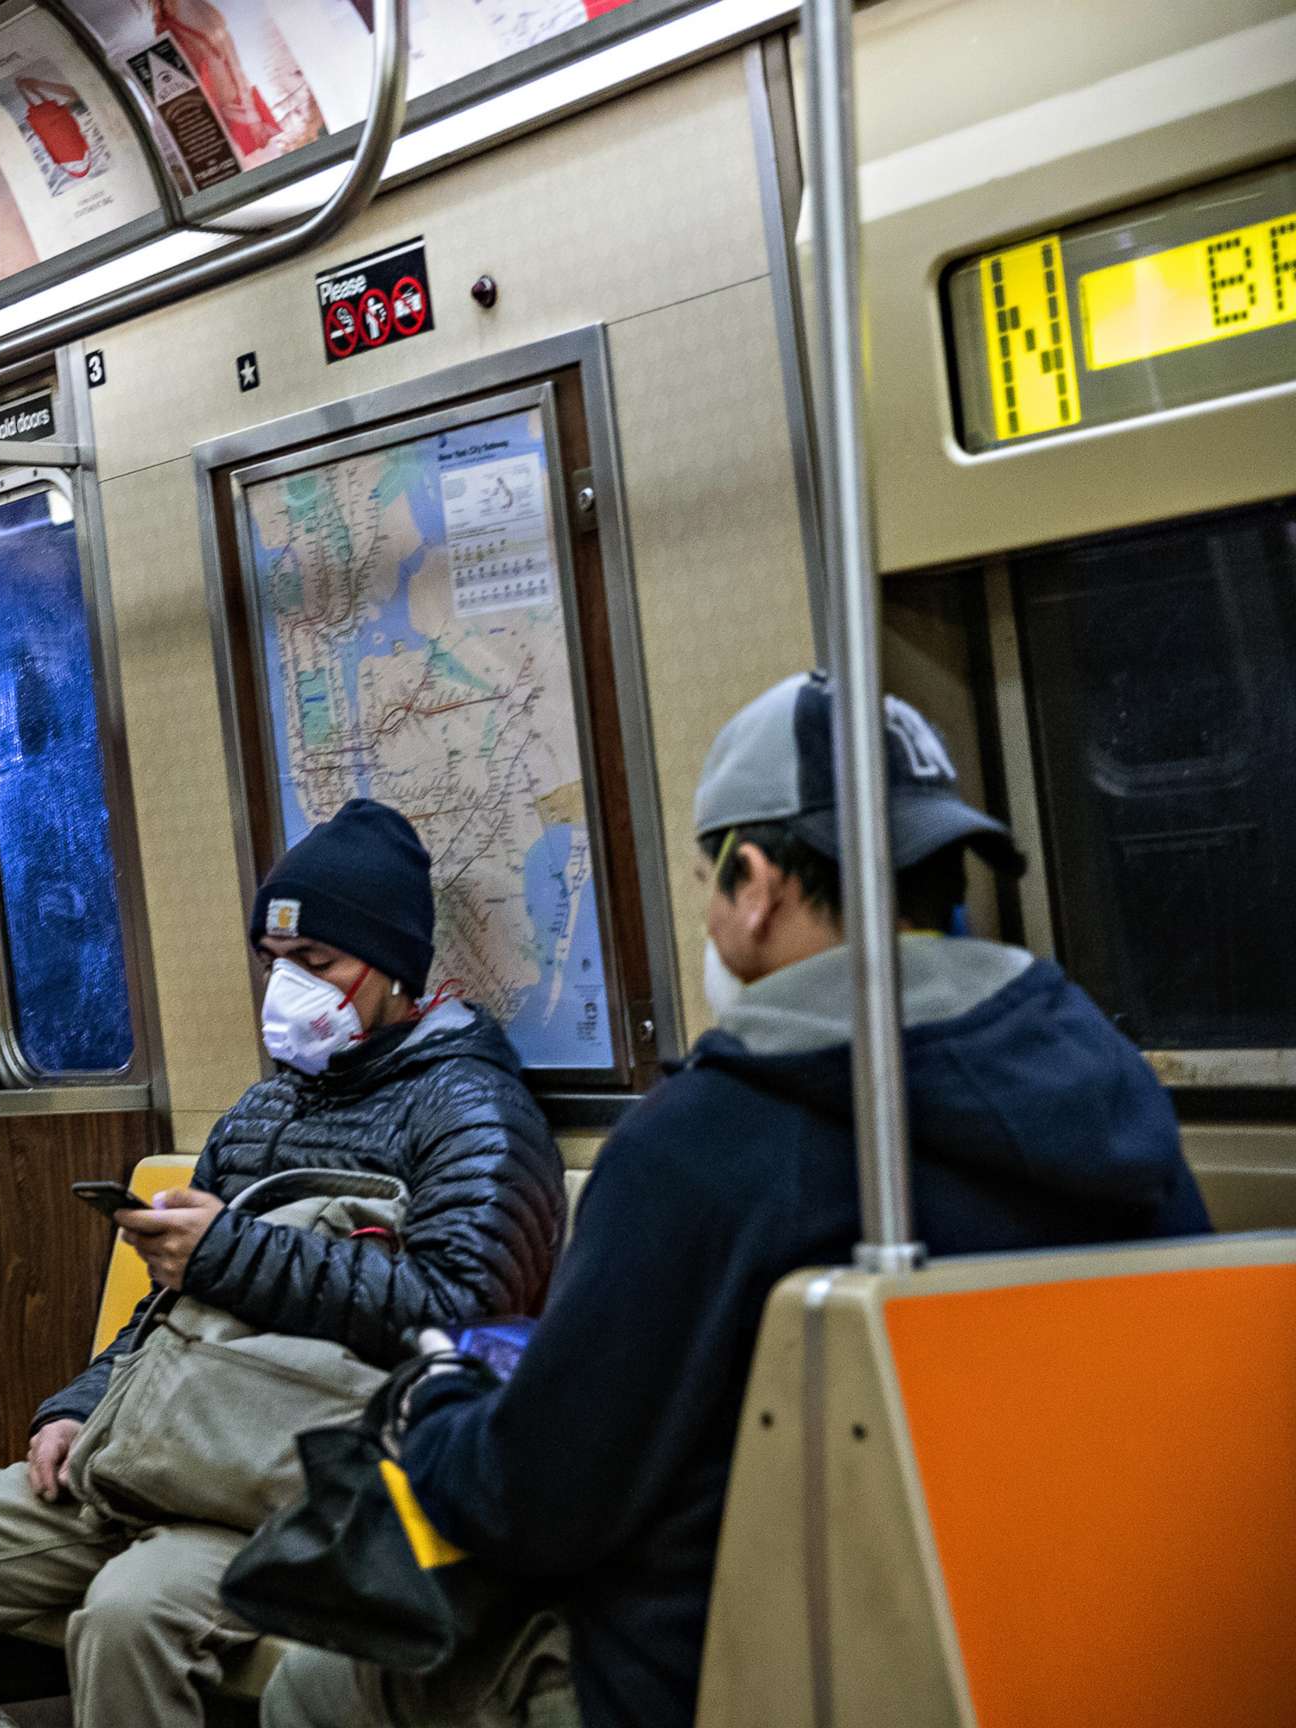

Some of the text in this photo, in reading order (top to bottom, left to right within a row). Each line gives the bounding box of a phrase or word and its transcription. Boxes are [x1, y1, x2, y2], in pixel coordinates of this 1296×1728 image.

[320, 274, 368, 306] Please
[990, 244, 1070, 434] N
[89, 356, 102, 383] 3
[17, 408, 50, 433] doors
